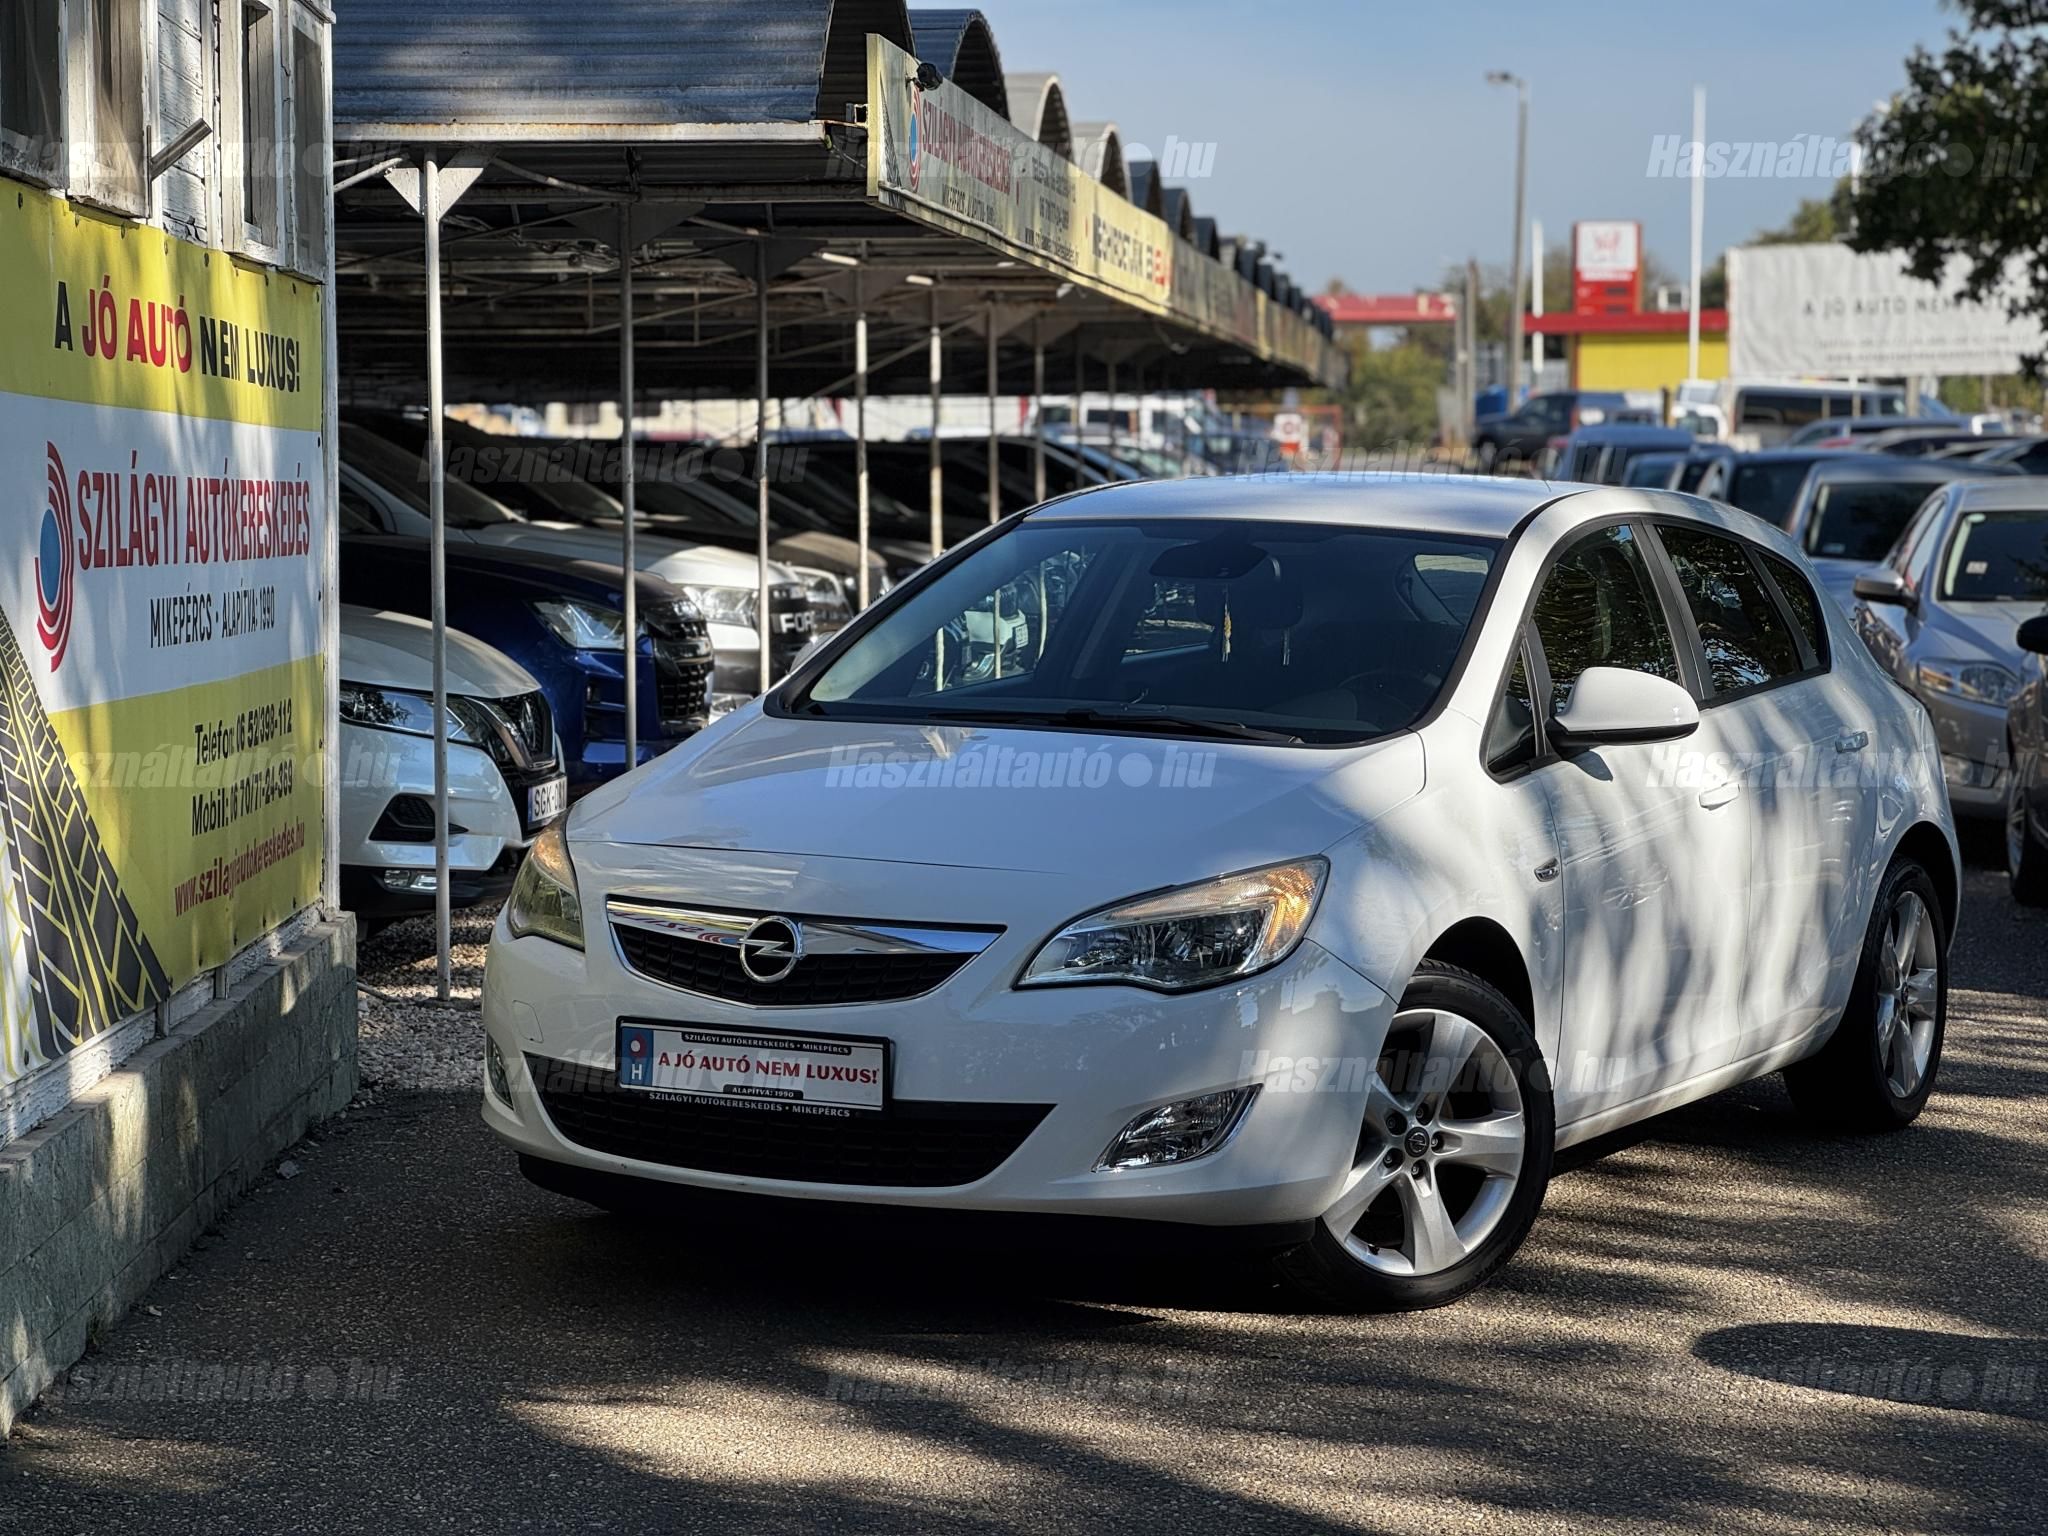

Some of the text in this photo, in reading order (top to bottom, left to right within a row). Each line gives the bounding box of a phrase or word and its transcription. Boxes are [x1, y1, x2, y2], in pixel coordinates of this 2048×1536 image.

[54, 275, 299, 392] A JÓ AUTÓ NEM LUXUS!
[77, 450, 309, 570] SZILÁGYI AUTÓKERESKEDÉS
[150, 578, 275, 648] MIKEPÉRCS ALAPÍTVA: 1990
[780, 611, 815, 633] FOR
[192, 787, 229, 836] Mobil:
[684, 1033, 849, 1054] SZILÁGYI AUTÓKERESKEDÉS MIKEPÉRCS
[631, 1064, 643, 1080] H
[658, 1050, 878, 1084] A JÓ AUTÓ NEM LUXUS!
[732, 1085, 794, 1098] ALAPÍTVA: 1990
[792, 1104, 850, 1117] MIKEPÉRCS
